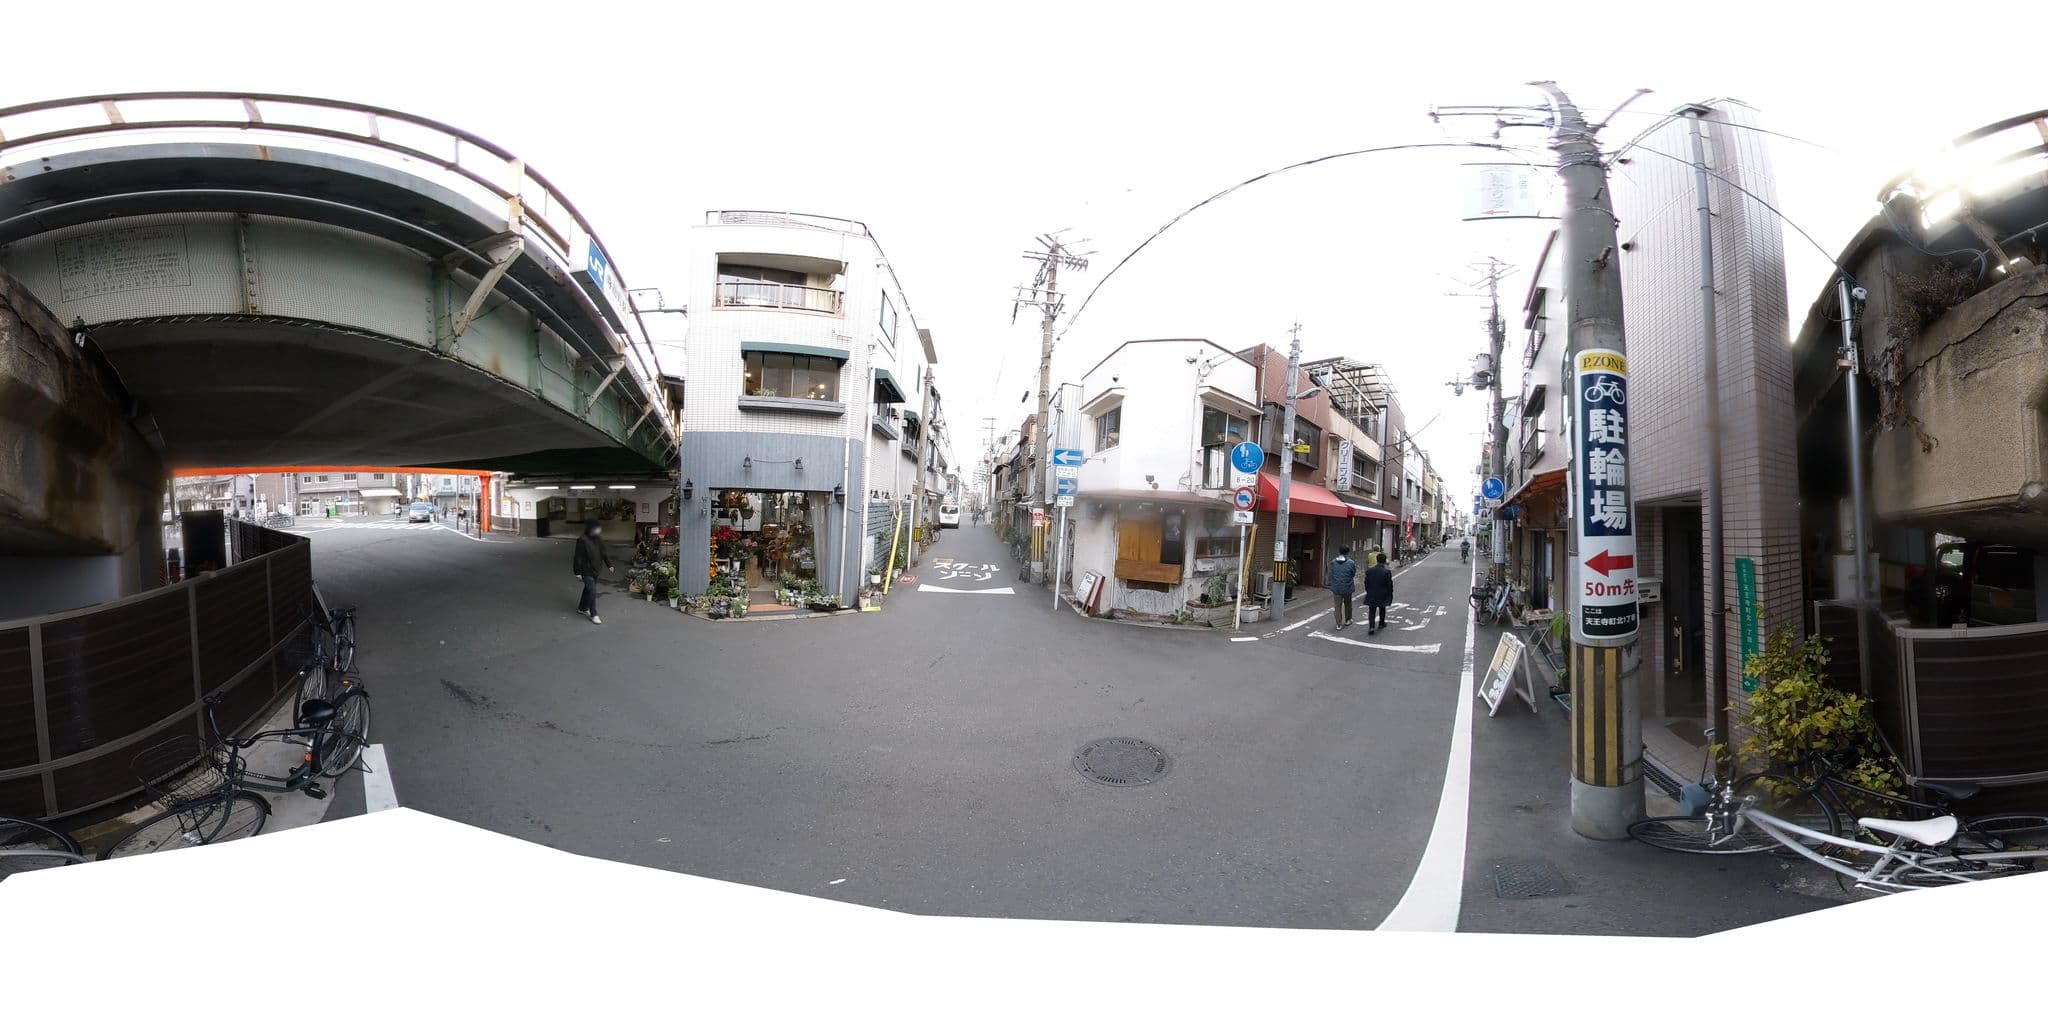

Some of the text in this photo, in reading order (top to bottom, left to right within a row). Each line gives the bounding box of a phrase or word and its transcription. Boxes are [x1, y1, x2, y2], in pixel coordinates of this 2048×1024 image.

[589, 255, 605, 281] JR
[1583, 355, 1627, 372] P.ZONE
[1339, 441, 1350, 485] クリーニング
[1588, 408, 1628, 530] 駐輪場
[933, 562, 1001, 572] スクール
[938, 570, 992, 581] ゾーン
[1584, 578, 1635, 597] 50m先
[1584, 607, 1602, 615] ここは
